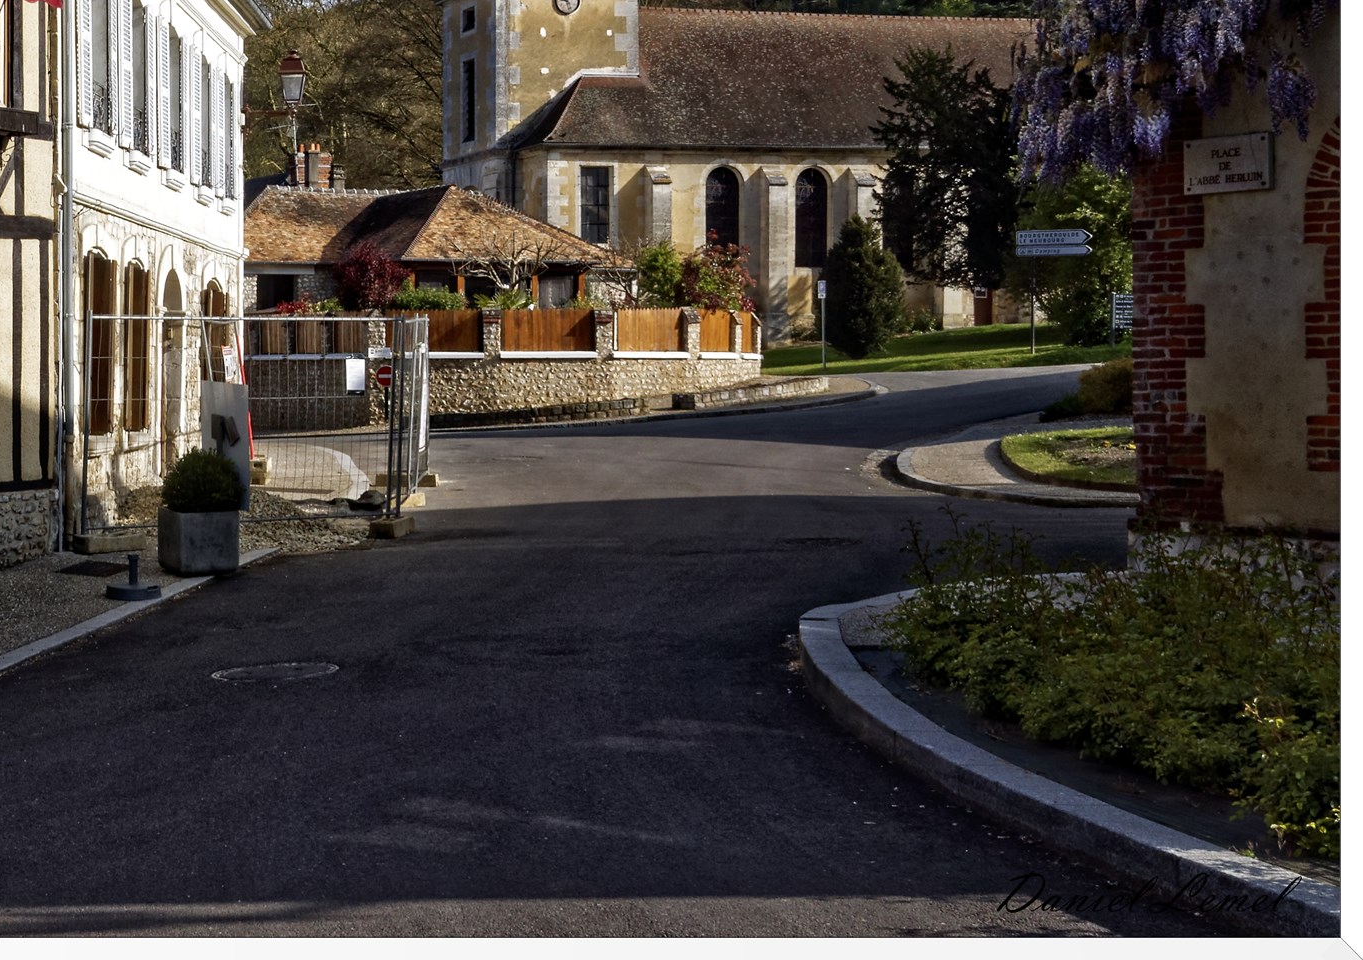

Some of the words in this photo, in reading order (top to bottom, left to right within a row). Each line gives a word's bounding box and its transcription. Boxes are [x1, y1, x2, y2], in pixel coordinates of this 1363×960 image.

[1211, 148, 1241, 159] PLACE
[1219, 161, 1231, 171] DE
[1225, 172, 1263, 183] HERLUIN
